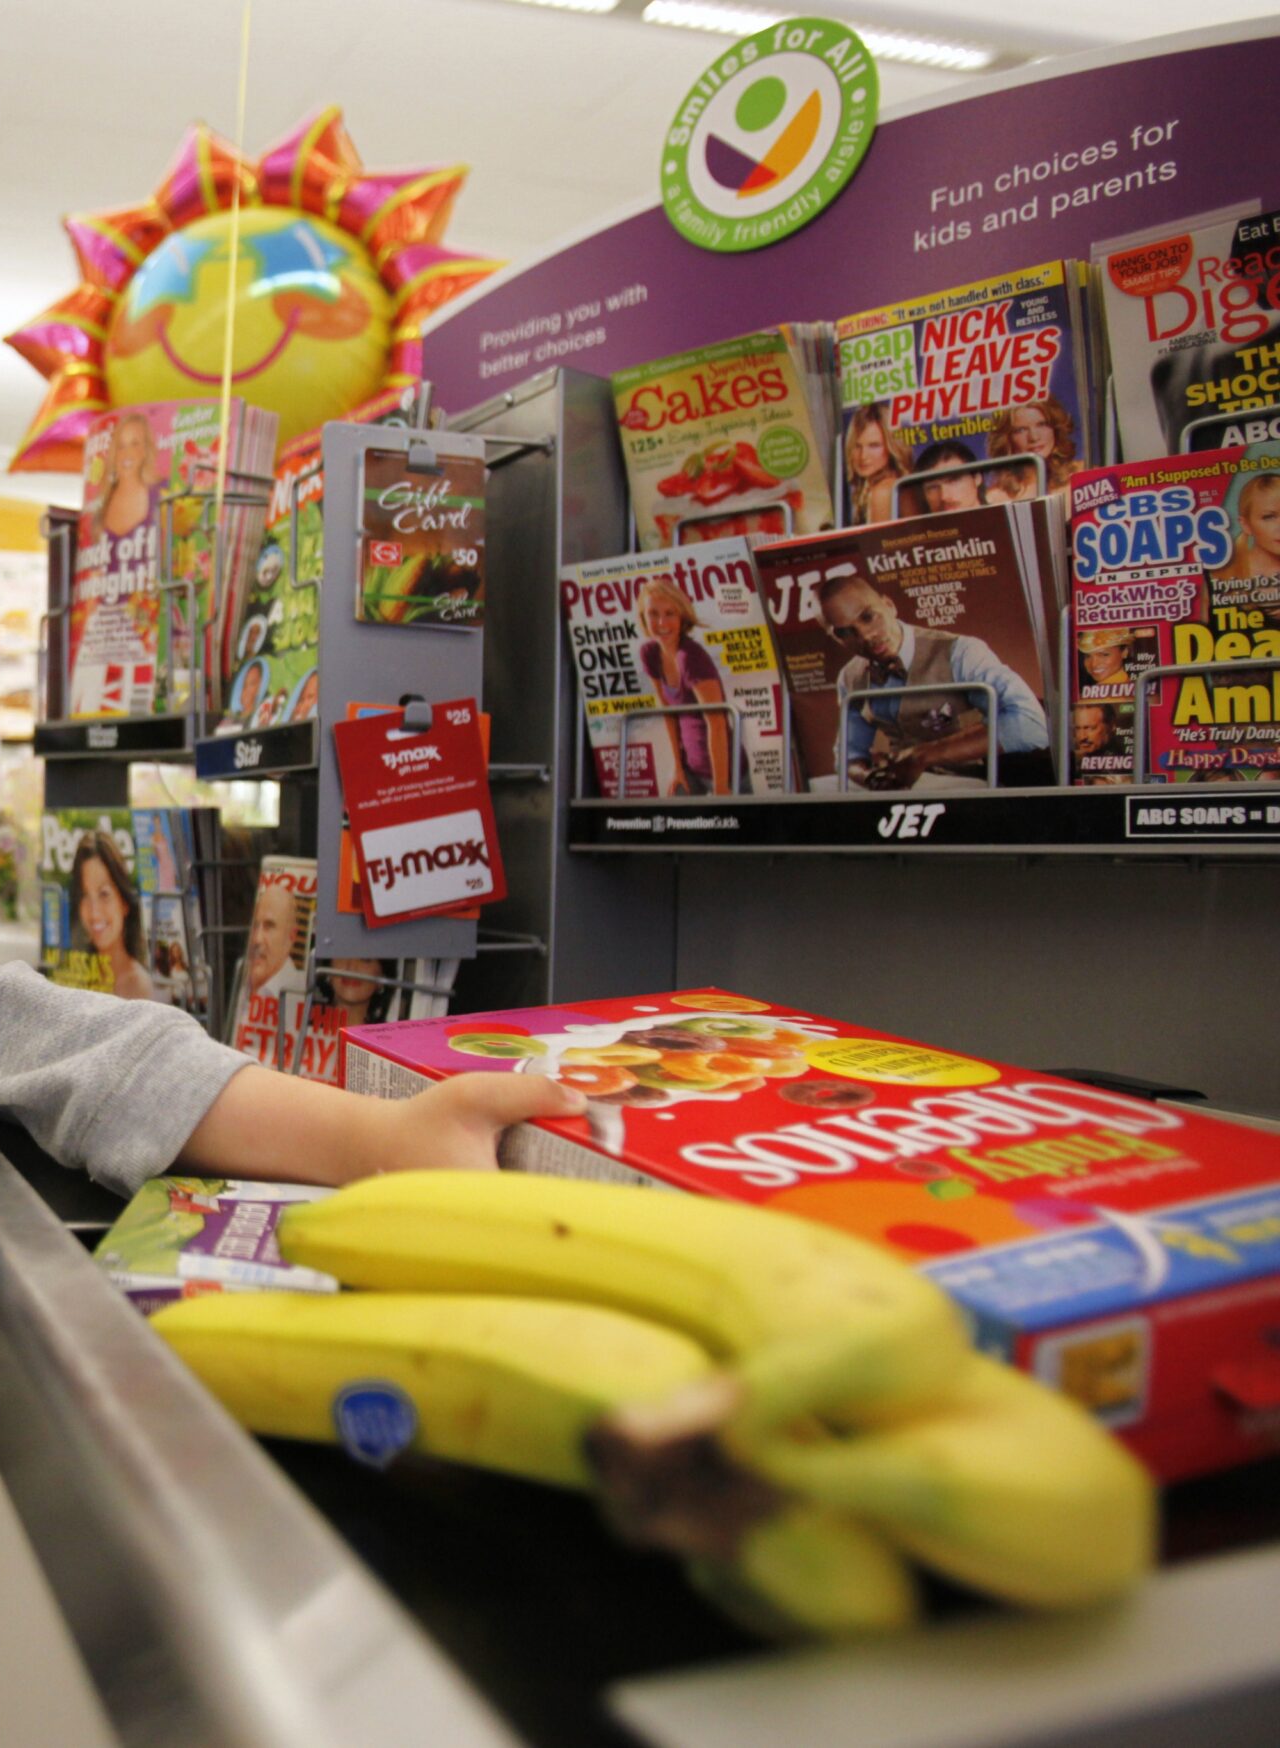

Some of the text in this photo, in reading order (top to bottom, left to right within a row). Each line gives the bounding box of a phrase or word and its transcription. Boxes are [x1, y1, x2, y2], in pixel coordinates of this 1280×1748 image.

[669, 24, 867, 147] Smiles for All
[930, 118, 1180, 213] Fun choices for
[674, 199, 729, 248] family
[732, 186, 822, 243] friendly
[913, 160, 1179, 253] kids and parents
[1238, 219, 1270, 242] Eat
[1110, 241, 1189, 271] HANG ON TO
[1119, 254, 1184, 278] YOUR JOB!
[1122, 272, 1155, 289] SMART
[1156, 267, 1182, 281] TIPS
[908, 304, 928, 317] was
[928, 300, 946, 313] not
[948, 288, 989, 308] handled
[991, 281, 1014, 298] with
[1020, 296, 1050, 309] YOUNG
[1027, 305, 1046, 317] AND
[479, 283, 649, 352] Providing you with
[922, 299, 1015, 353] NICK
[1015, 311, 1058, 328] RESTLESS
[479, 349, 531, 379] better
[533, 325, 607, 362] choices
[840, 328, 914, 368] soap
[922, 327, 1061, 387] LEAVES
[860, 358, 894, 372] OPERA
[841, 356, 916, 406] digest
[621, 366, 789, 432] Cakes
[890, 366, 1051, 428] PHYLLIS!
[931, 408, 1004, 441] terrible."
[1157, 463, 1221, 485] Supposed
[1221, 461, 1238, 475] To
[1239, 458, 1260, 473] Be
[378, 479, 451, 515] Gift
[1073, 478, 1115, 505] DIVA
[1096, 487, 1196, 522] CBS
[392, 501, 473, 535] Card
[866, 537, 997, 575] Kirk Franklin
[1074, 507, 1231, 582] SOAPS
[1097, 564, 1201, 584] IN DEPTH
[1212, 576, 1252, 591] Trying
[1253, 575, 1269, 587] To
[559, 556, 757, 621] Prevtion
[917, 592, 960, 609] GOD'S
[1076, 580, 1197, 607] Look Who's
[1212, 592, 1250, 607] Kevin
[439, 604, 479, 621] Card
[1076, 601, 1191, 626] Returning!
[1212, 606, 1265, 632] The
[573, 619, 639, 647] Shrink
[706, 627, 762, 645] FLATTEN
[726, 639, 764, 651] BELLY
[578, 643, 635, 672] ONE
[726, 650, 767, 664] BULGE
[732, 662, 754, 674] After
[1136, 652, 1156, 665] Why
[583, 670, 642, 699] SIZE
[733, 685, 770, 701] Always
[1081, 684, 1110, 699] DRU
[738, 708, 772, 721] nergy
[745, 697, 770, 708] Have
[446, 708, 472, 726] $25
[1173, 727, 1206, 743] "He's
[1208, 726, 1244, 743] Truly
[233, 739, 263, 769] Star
[600, 747, 648, 761] POER
[1080, 755, 1133, 770] REVENG
[1166, 747, 1228, 770] Happy
[607, 817, 652, 831] Prevention
[877, 803, 946, 839] JET
[1136, 808, 1177, 826] ABC
[1179, 806, 1247, 825] SOAPS
[679, 1082, 1187, 1187] Cheerios
[944, 1127, 1184, 1186] Fruity
